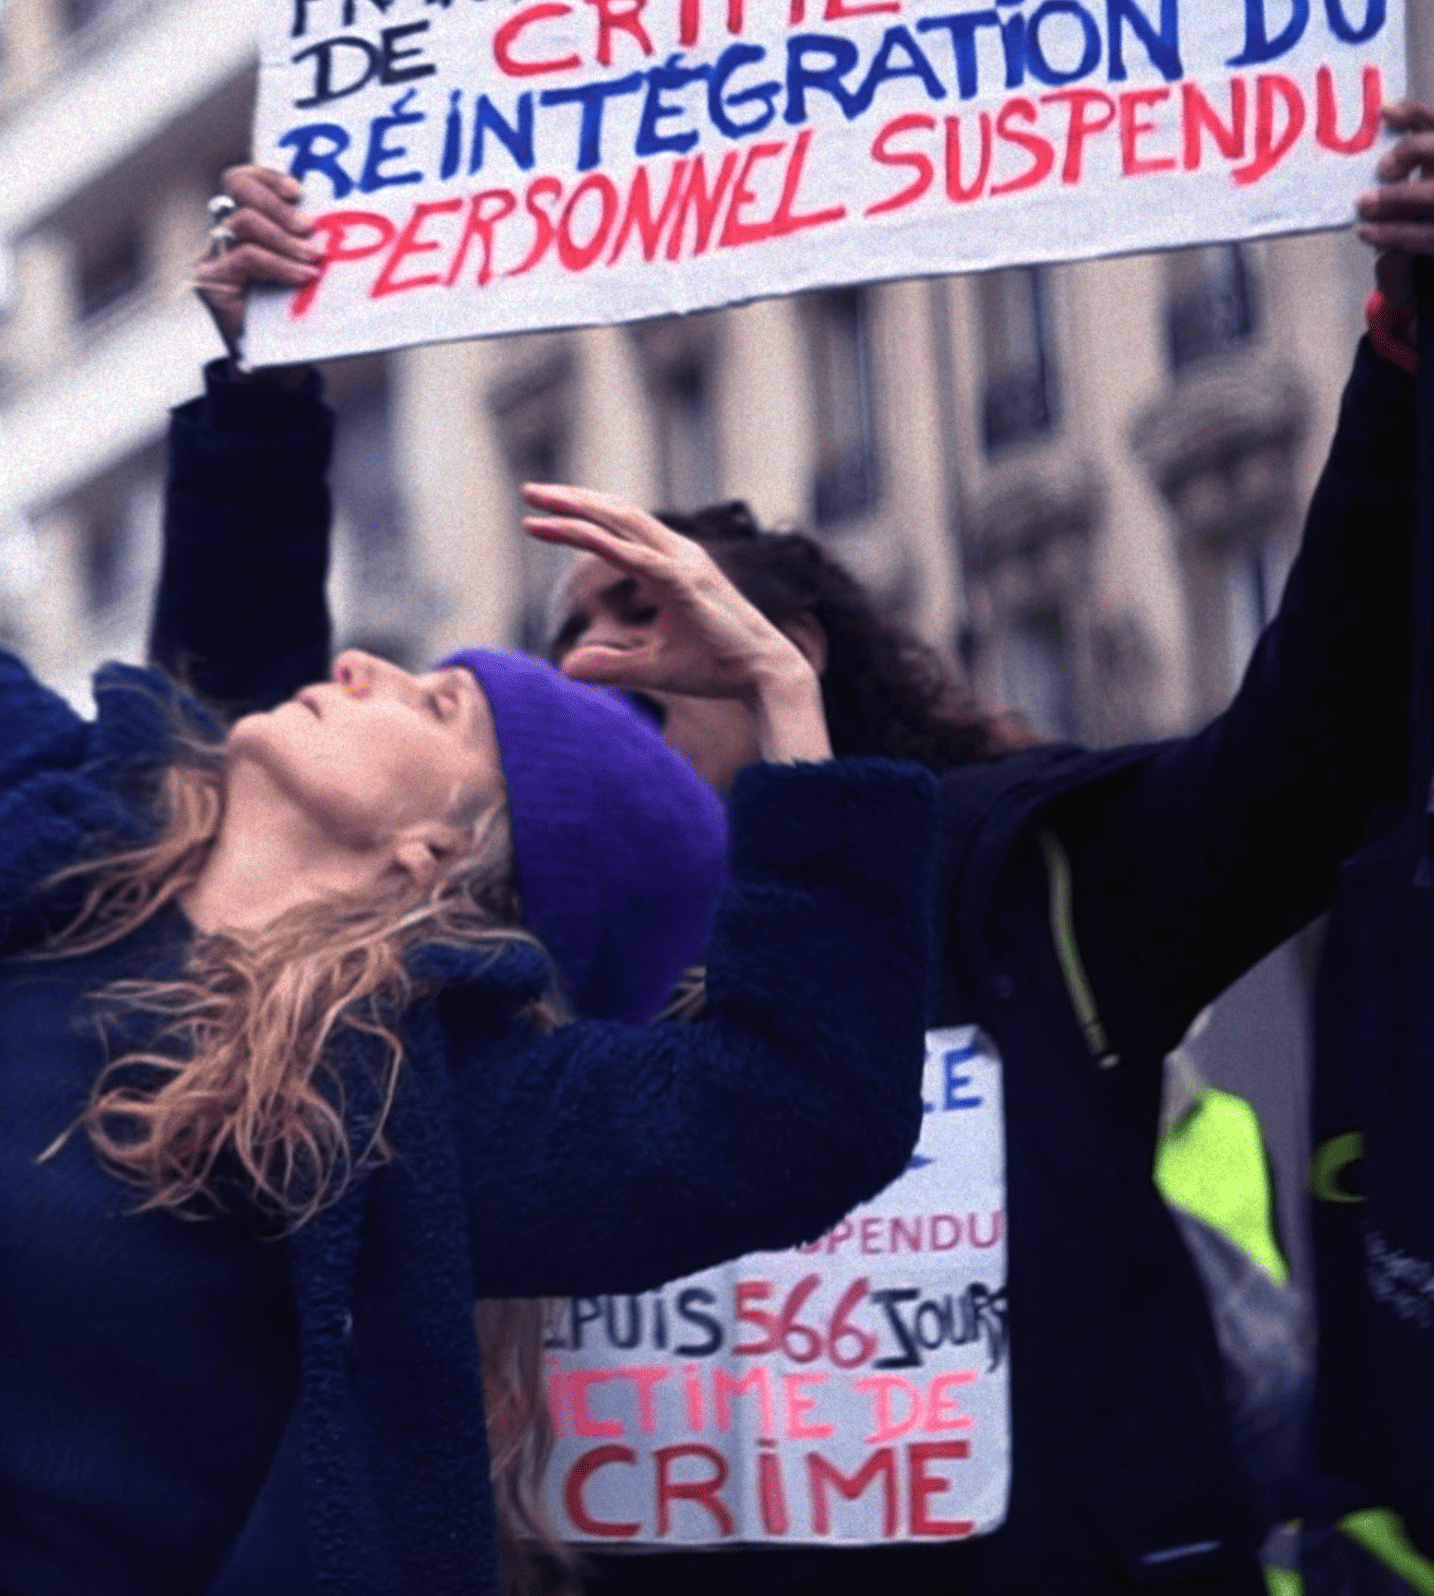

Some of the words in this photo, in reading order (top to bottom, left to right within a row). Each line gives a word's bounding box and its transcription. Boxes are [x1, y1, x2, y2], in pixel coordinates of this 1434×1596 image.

[291, 19, 437, 109] DE
[493, 0, 901, 77] CRI
[1225, 0, 1386, 67] DU
[290, 129, 846, 317] PERSONNEL
[865, 64, 1381, 216] SUSPENDU
[795, 1210, 1004, 1255] PENDU
[543, 1286, 724, 1358] PUIS
[731, 1274, 878, 1369] 566
[547, 1351, 835, 1439] ICTIME
[855, 1369, 978, 1444] DE
[563, 1438, 975, 1538] CRIME
